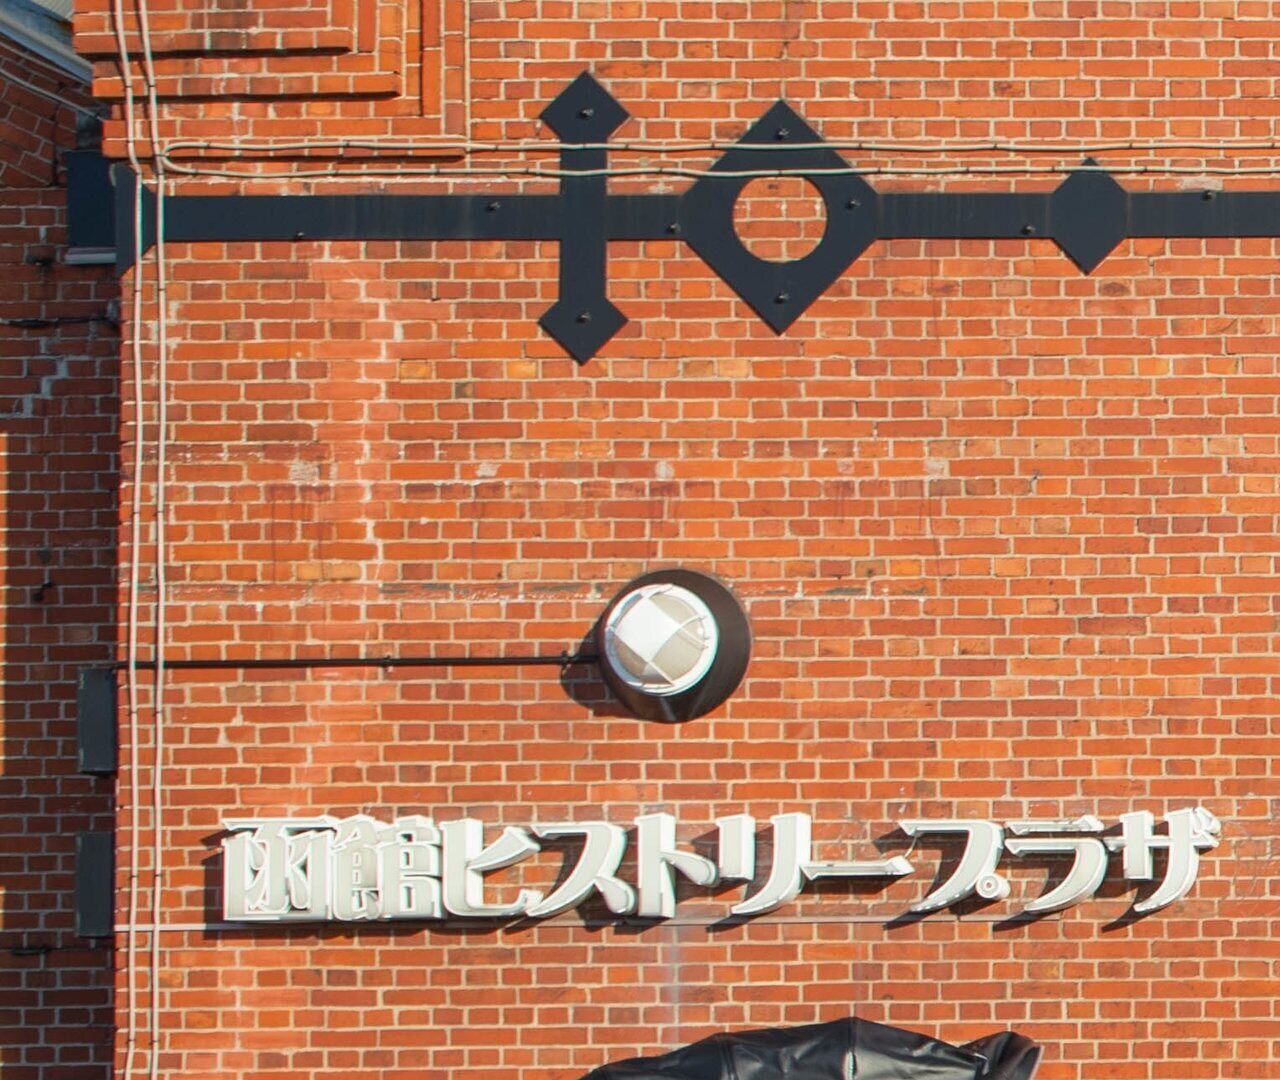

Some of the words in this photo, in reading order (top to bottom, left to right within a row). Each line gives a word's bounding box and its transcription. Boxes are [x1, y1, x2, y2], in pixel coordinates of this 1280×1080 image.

[221, 807, 1221, 921] 函館ヒストリープラザ
